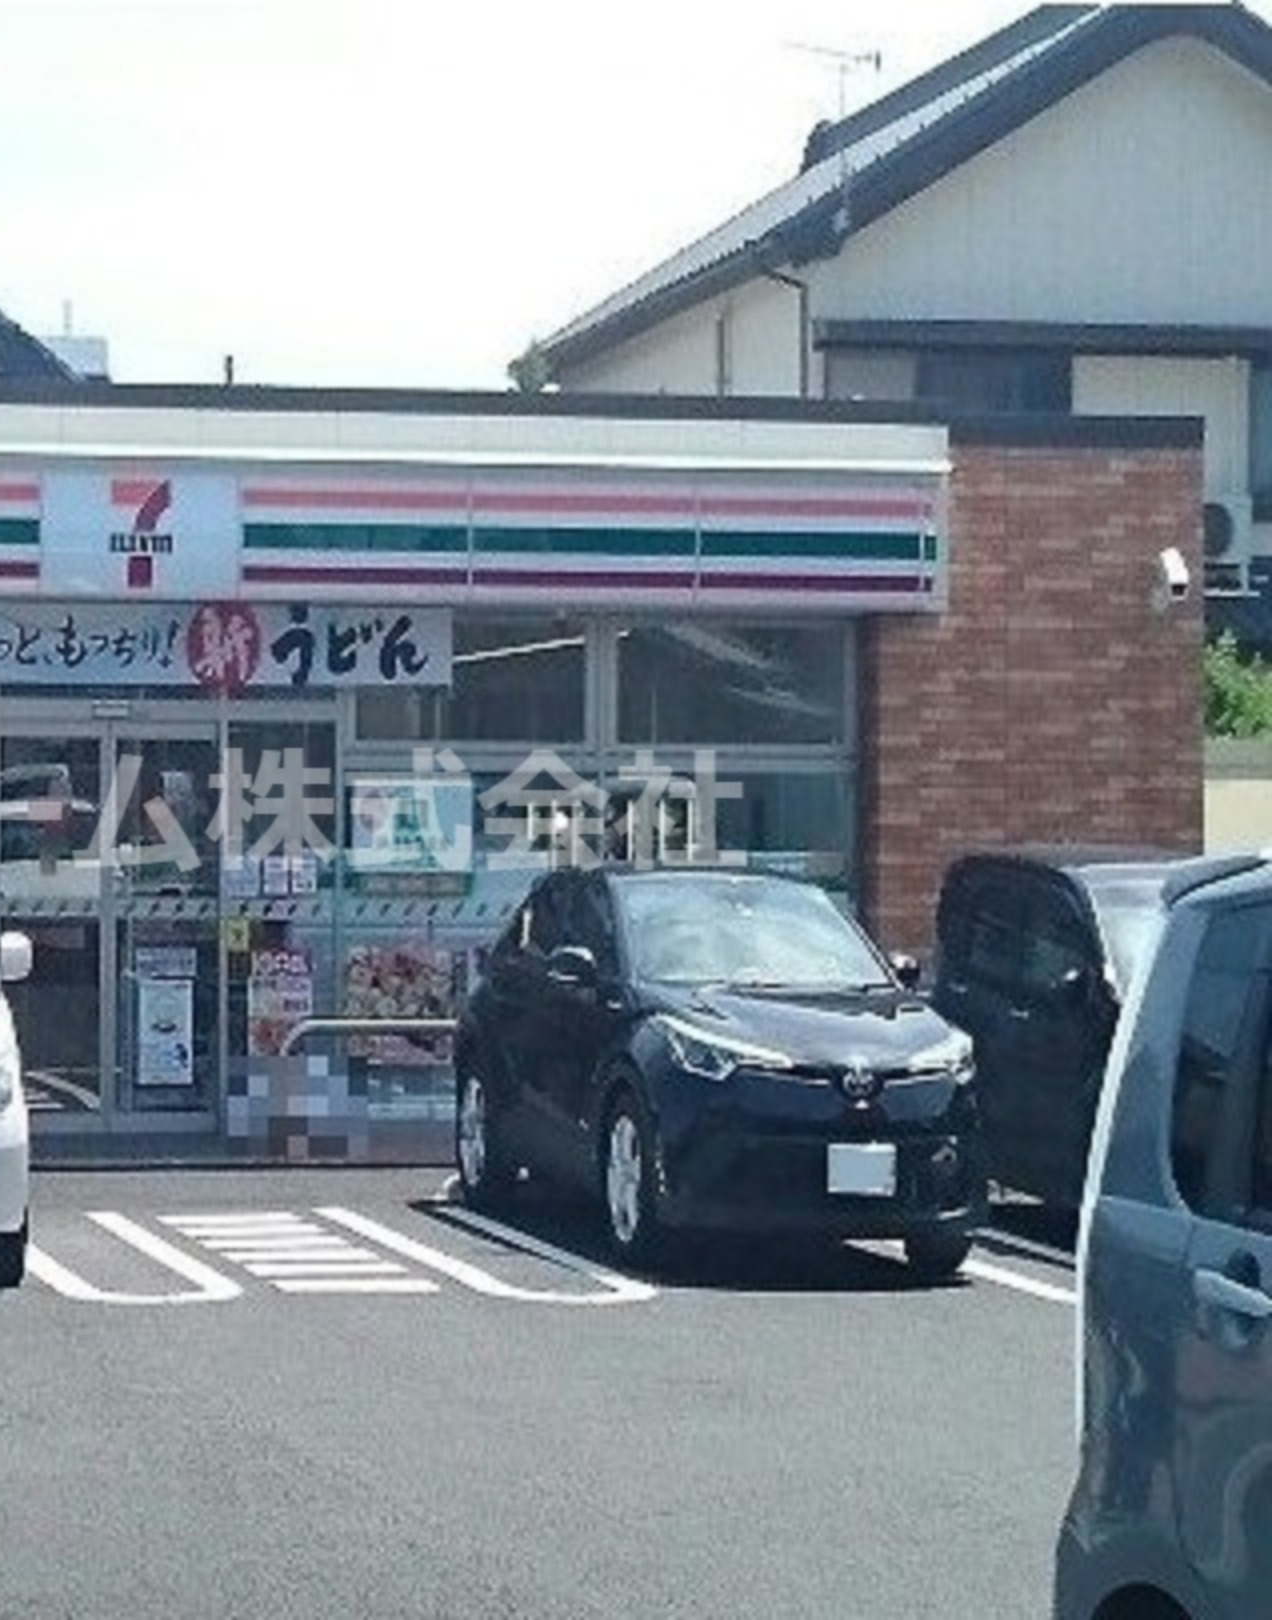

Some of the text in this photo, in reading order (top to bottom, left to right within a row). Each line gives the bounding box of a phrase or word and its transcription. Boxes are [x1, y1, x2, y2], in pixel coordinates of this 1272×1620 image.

[111, 479, 171, 589] 7
[270, 603, 428, 685] うどん
